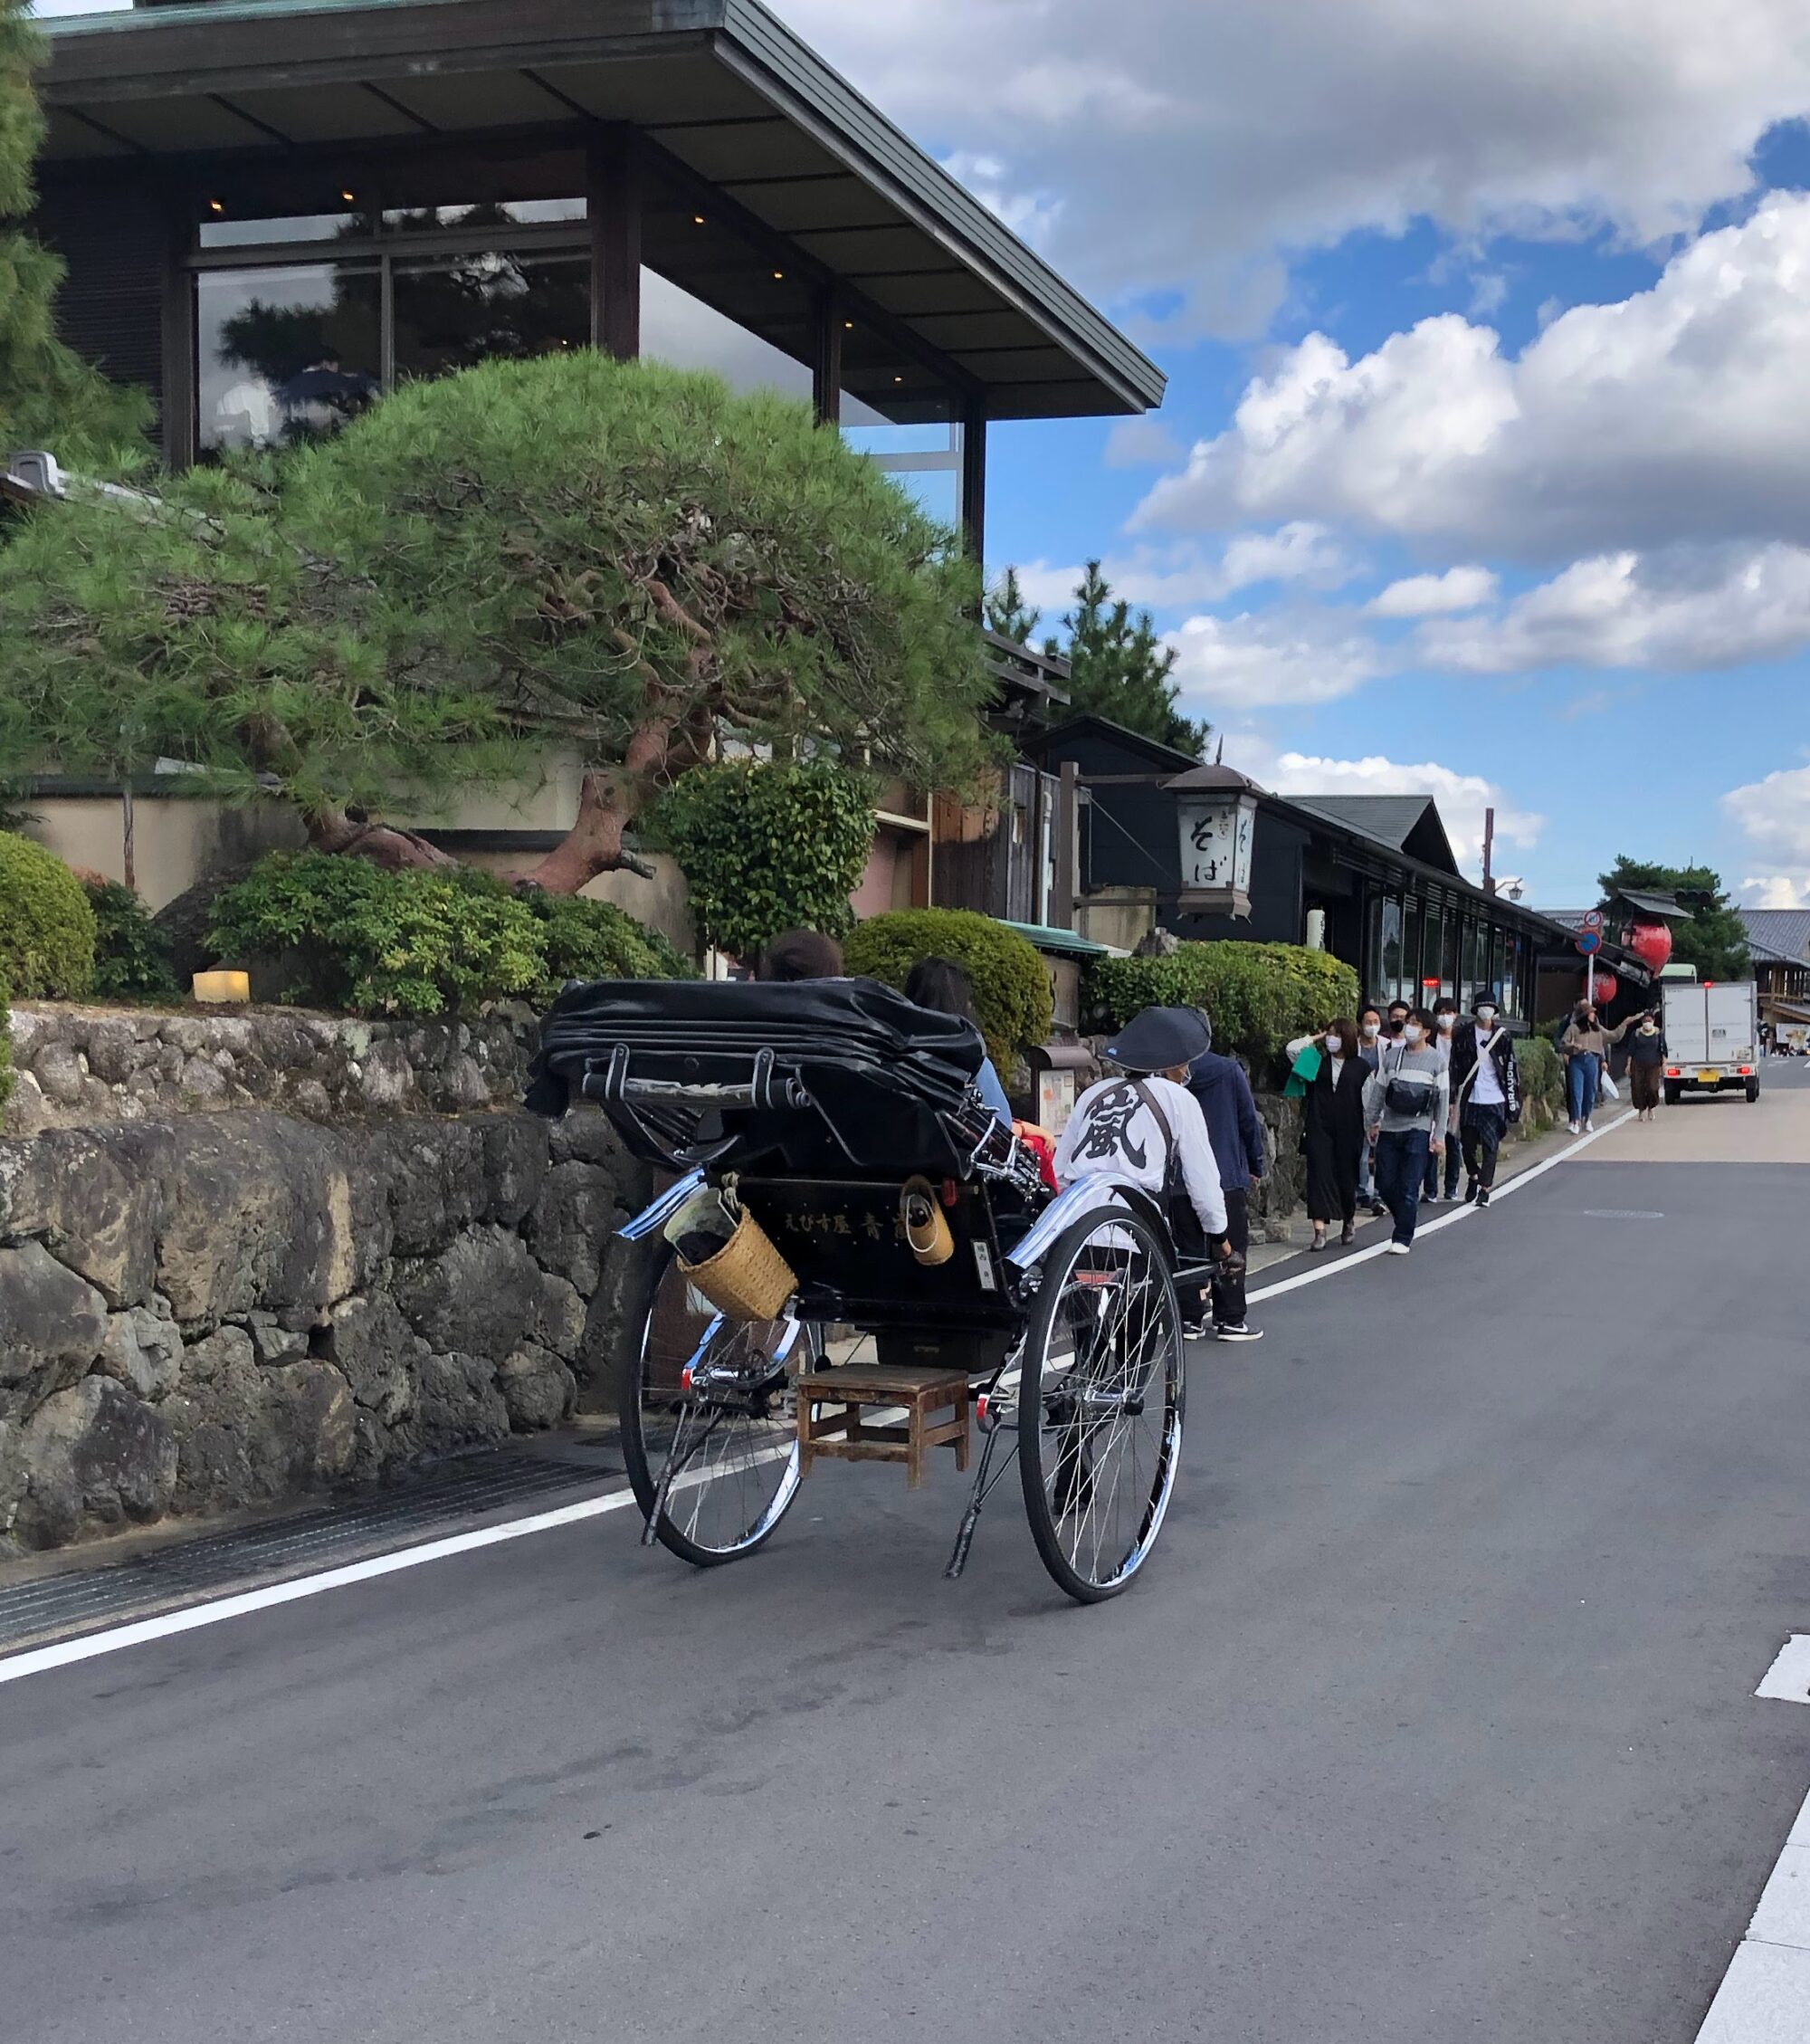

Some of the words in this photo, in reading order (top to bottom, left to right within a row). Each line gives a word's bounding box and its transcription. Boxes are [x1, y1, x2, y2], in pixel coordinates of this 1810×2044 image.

[1190, 816, 1227, 883] そば
[784, 1212, 853, 1235] えびす屋
